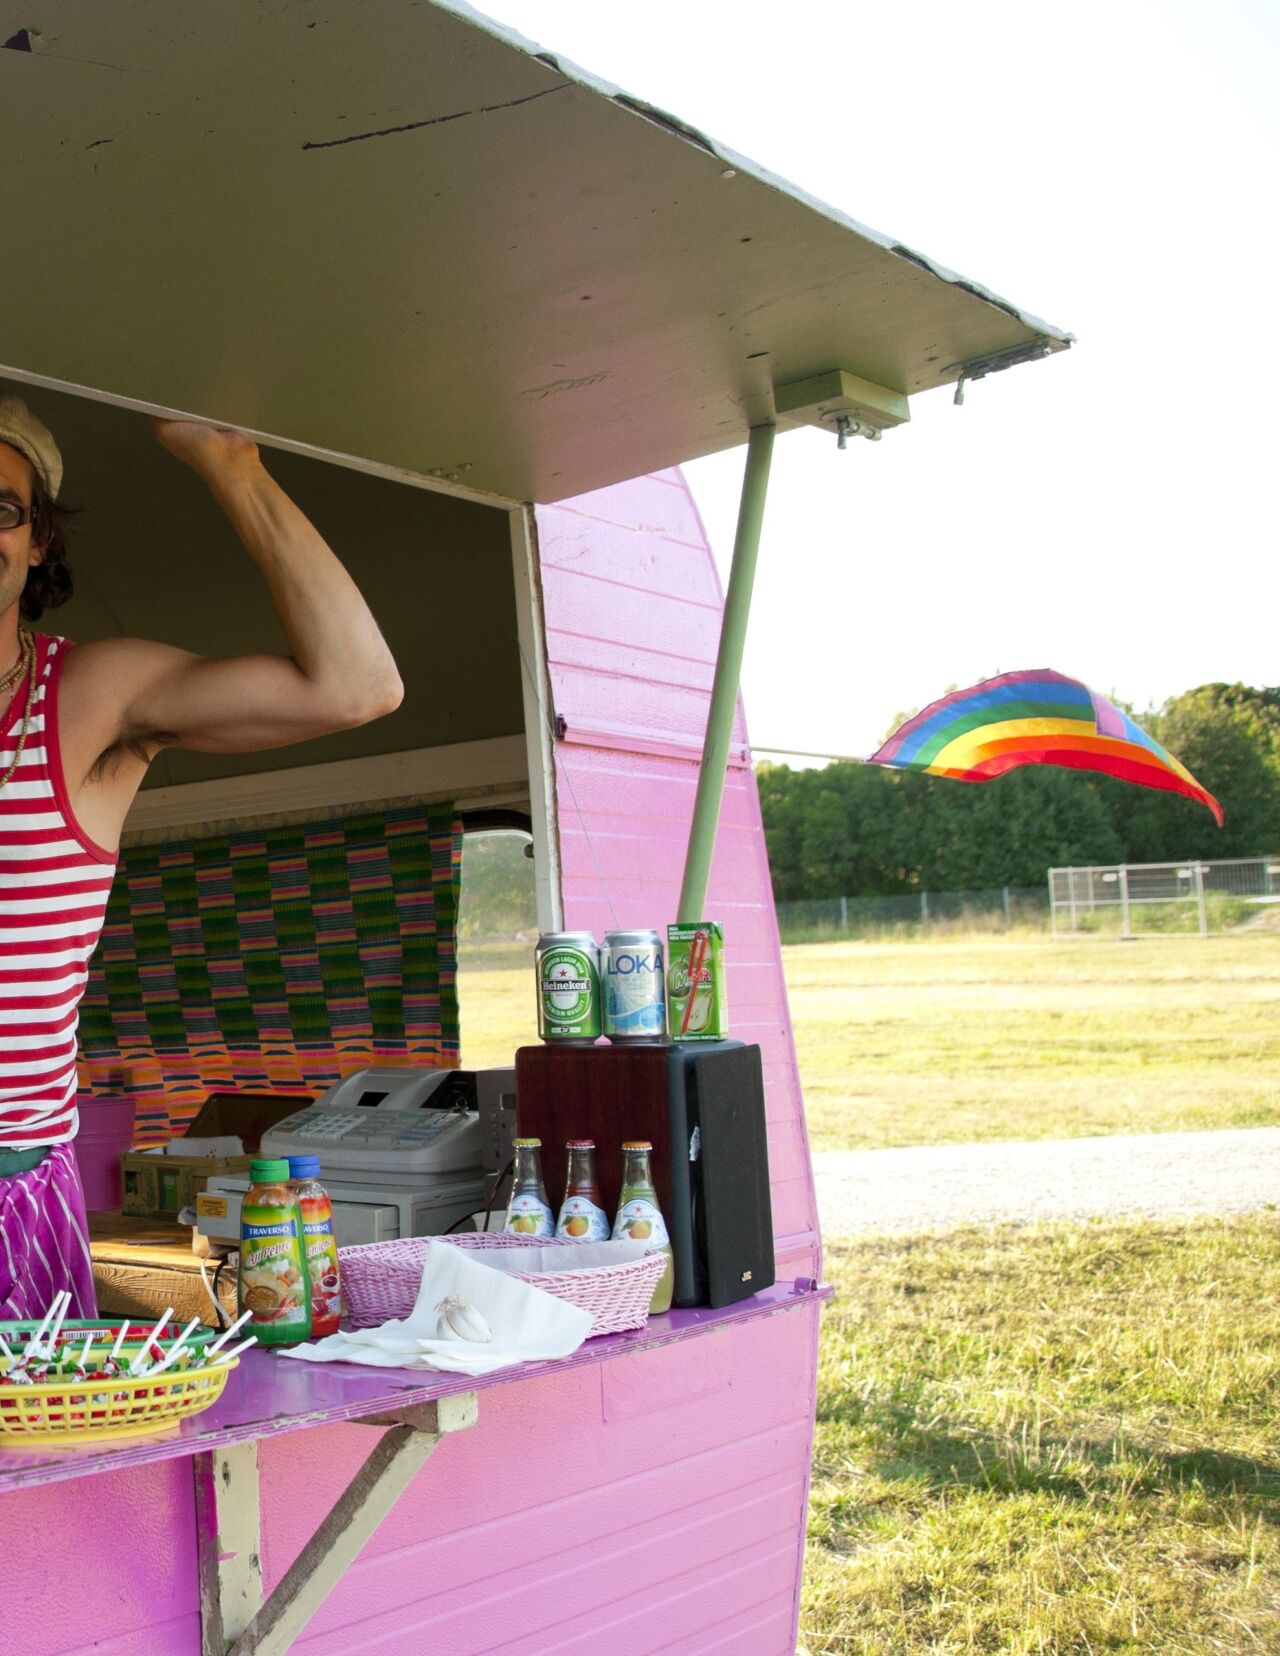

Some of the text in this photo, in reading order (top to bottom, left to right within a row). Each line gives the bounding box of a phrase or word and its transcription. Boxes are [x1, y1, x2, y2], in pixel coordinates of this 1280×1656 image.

[608, 955, 663, 974] LOKA
[543, 981, 587, 990] Heineken
[248, 1225, 289, 1236] TRAVERSO
[303, 1224, 328, 1233] AVERSO
